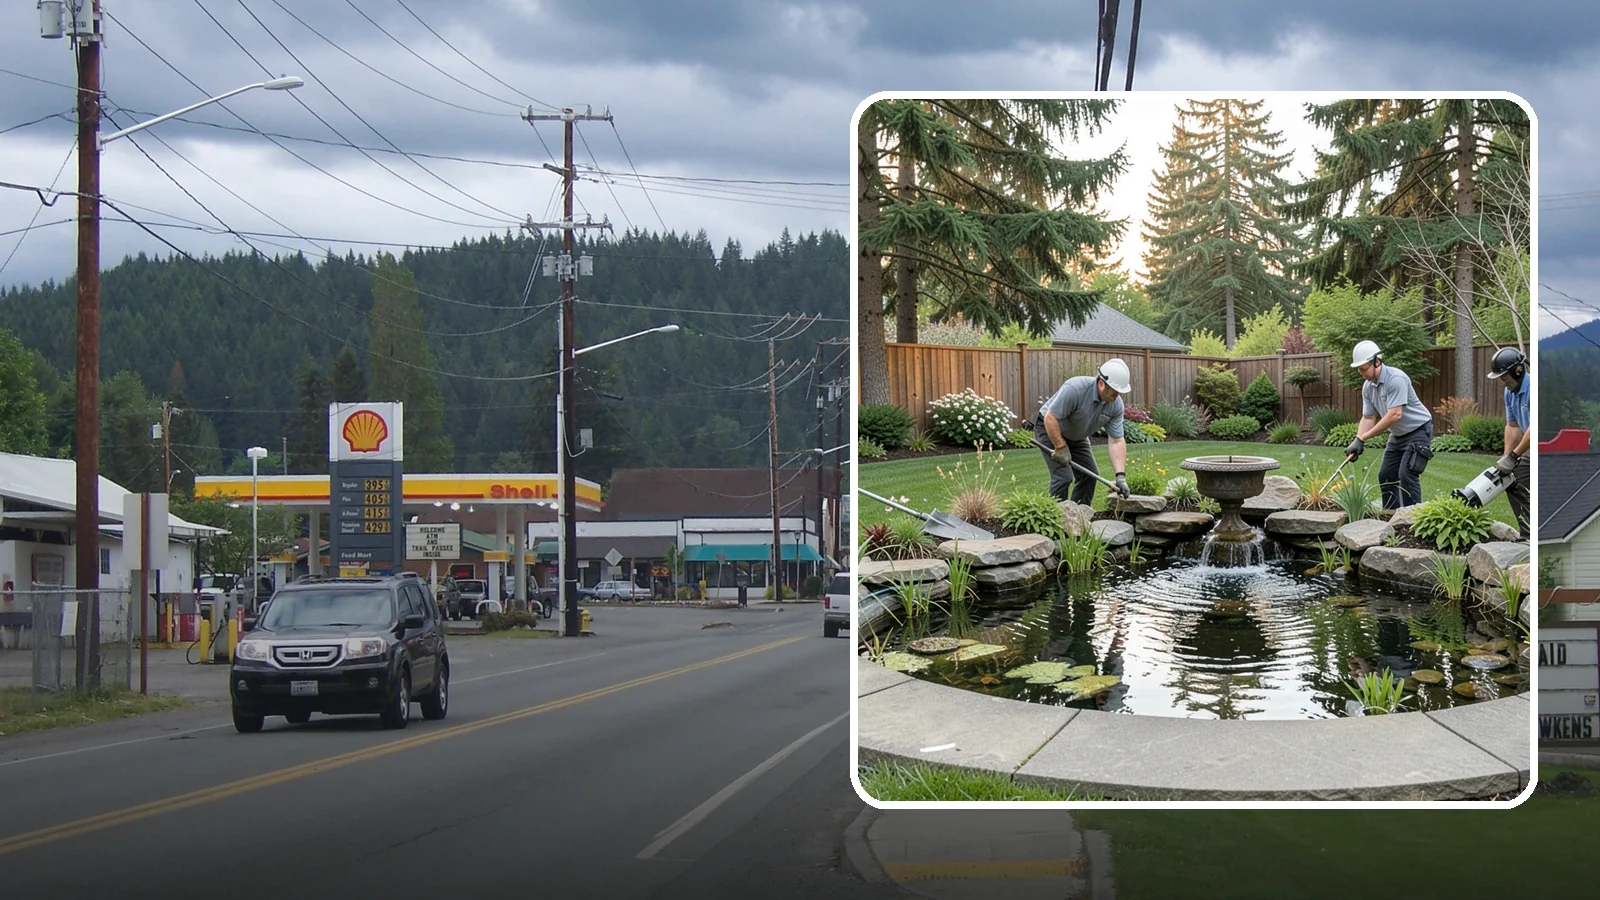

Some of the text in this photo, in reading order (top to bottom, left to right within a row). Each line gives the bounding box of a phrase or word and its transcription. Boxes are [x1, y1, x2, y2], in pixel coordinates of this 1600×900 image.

[366, 480, 384, 490] 395
[490, 484, 547, 499] Shell
[365, 494, 383, 504] 405
[365, 508, 383, 518] 415
[365, 522, 383, 532] 429
